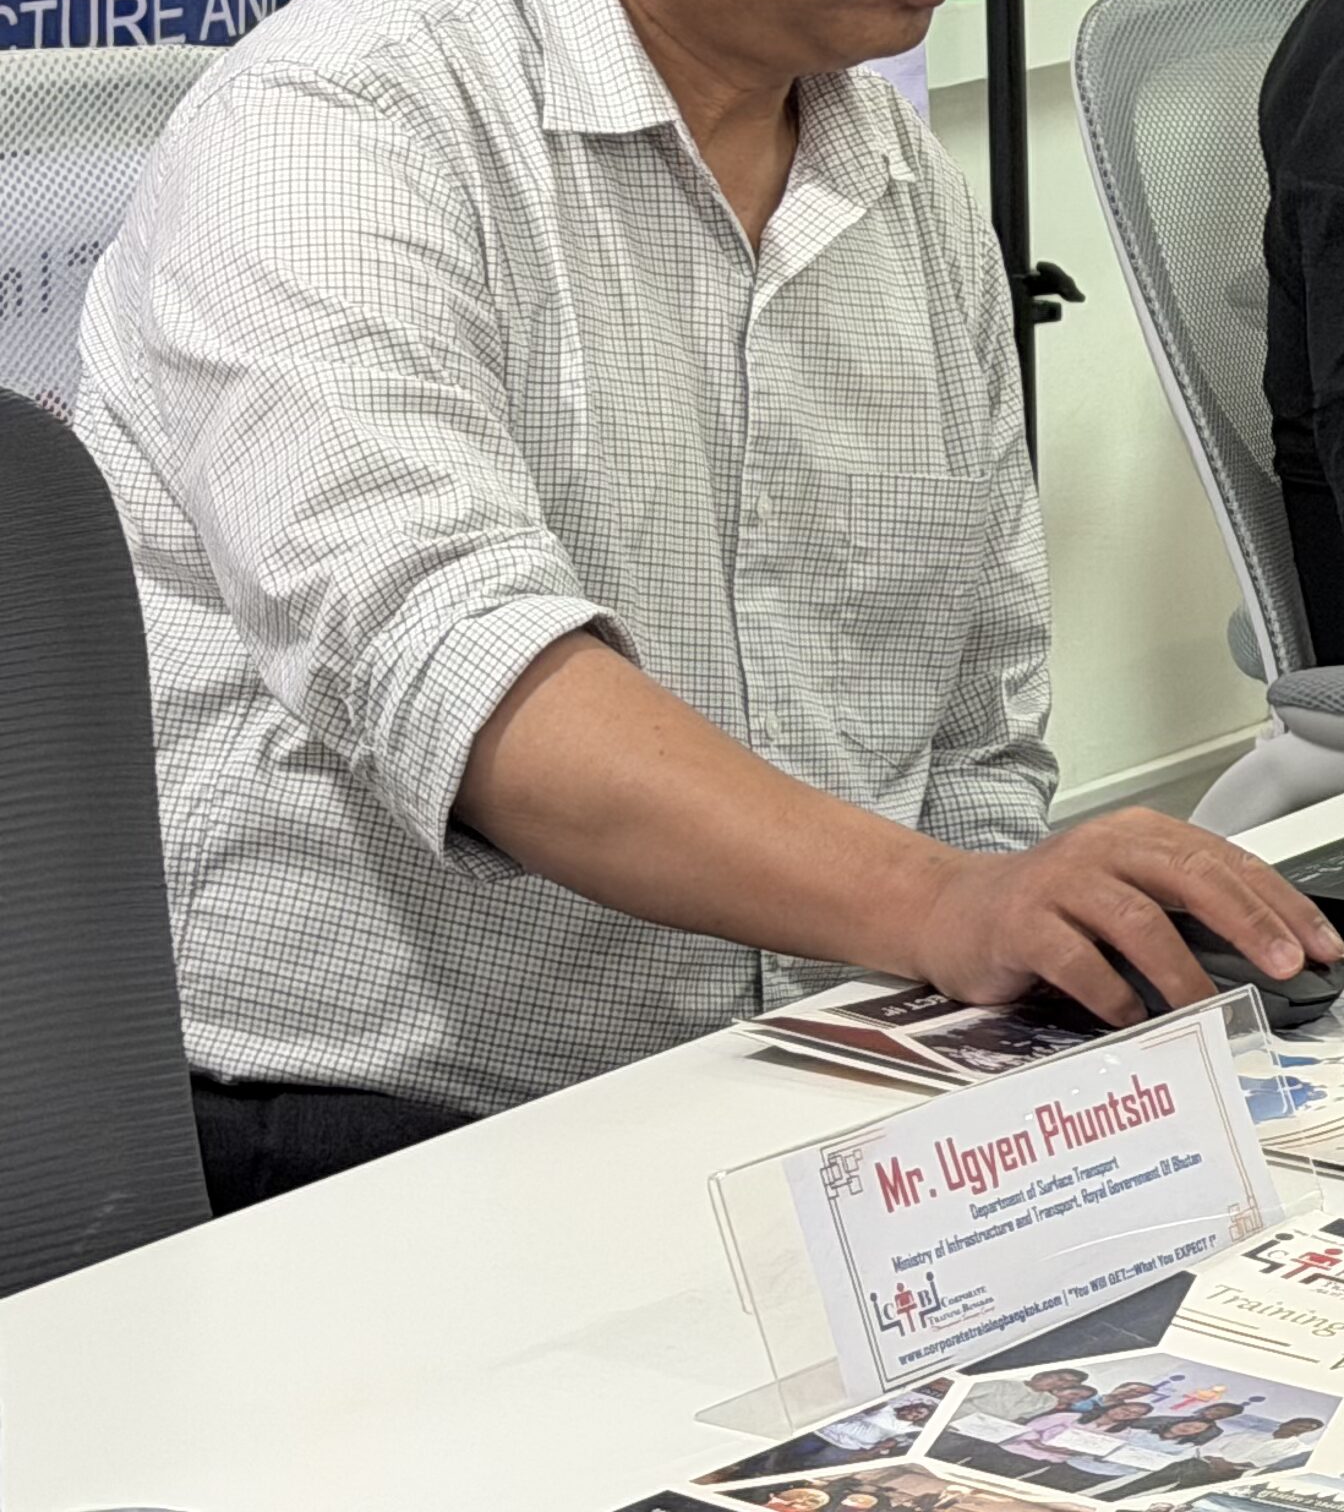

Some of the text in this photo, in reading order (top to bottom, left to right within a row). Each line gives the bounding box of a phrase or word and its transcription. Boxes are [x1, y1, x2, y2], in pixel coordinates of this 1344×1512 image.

[874, 1074, 1176, 1213] Mr. Ugyen Phuntsho
[891, 1247, 933, 1273] Ministry
[935, 1240, 946, 1258] of
[946, 1219, 1014, 1255] Infrastructure
[1015, 1208, 1033, 1229] and
[1080, 1184, 1107, 1206] Royal
[1107, 1167, 1160, 1197] Government
[969, 1156, 1119, 1220] Department of Surface Transport
[1174, 1239, 1209, 1262] EXPECT
